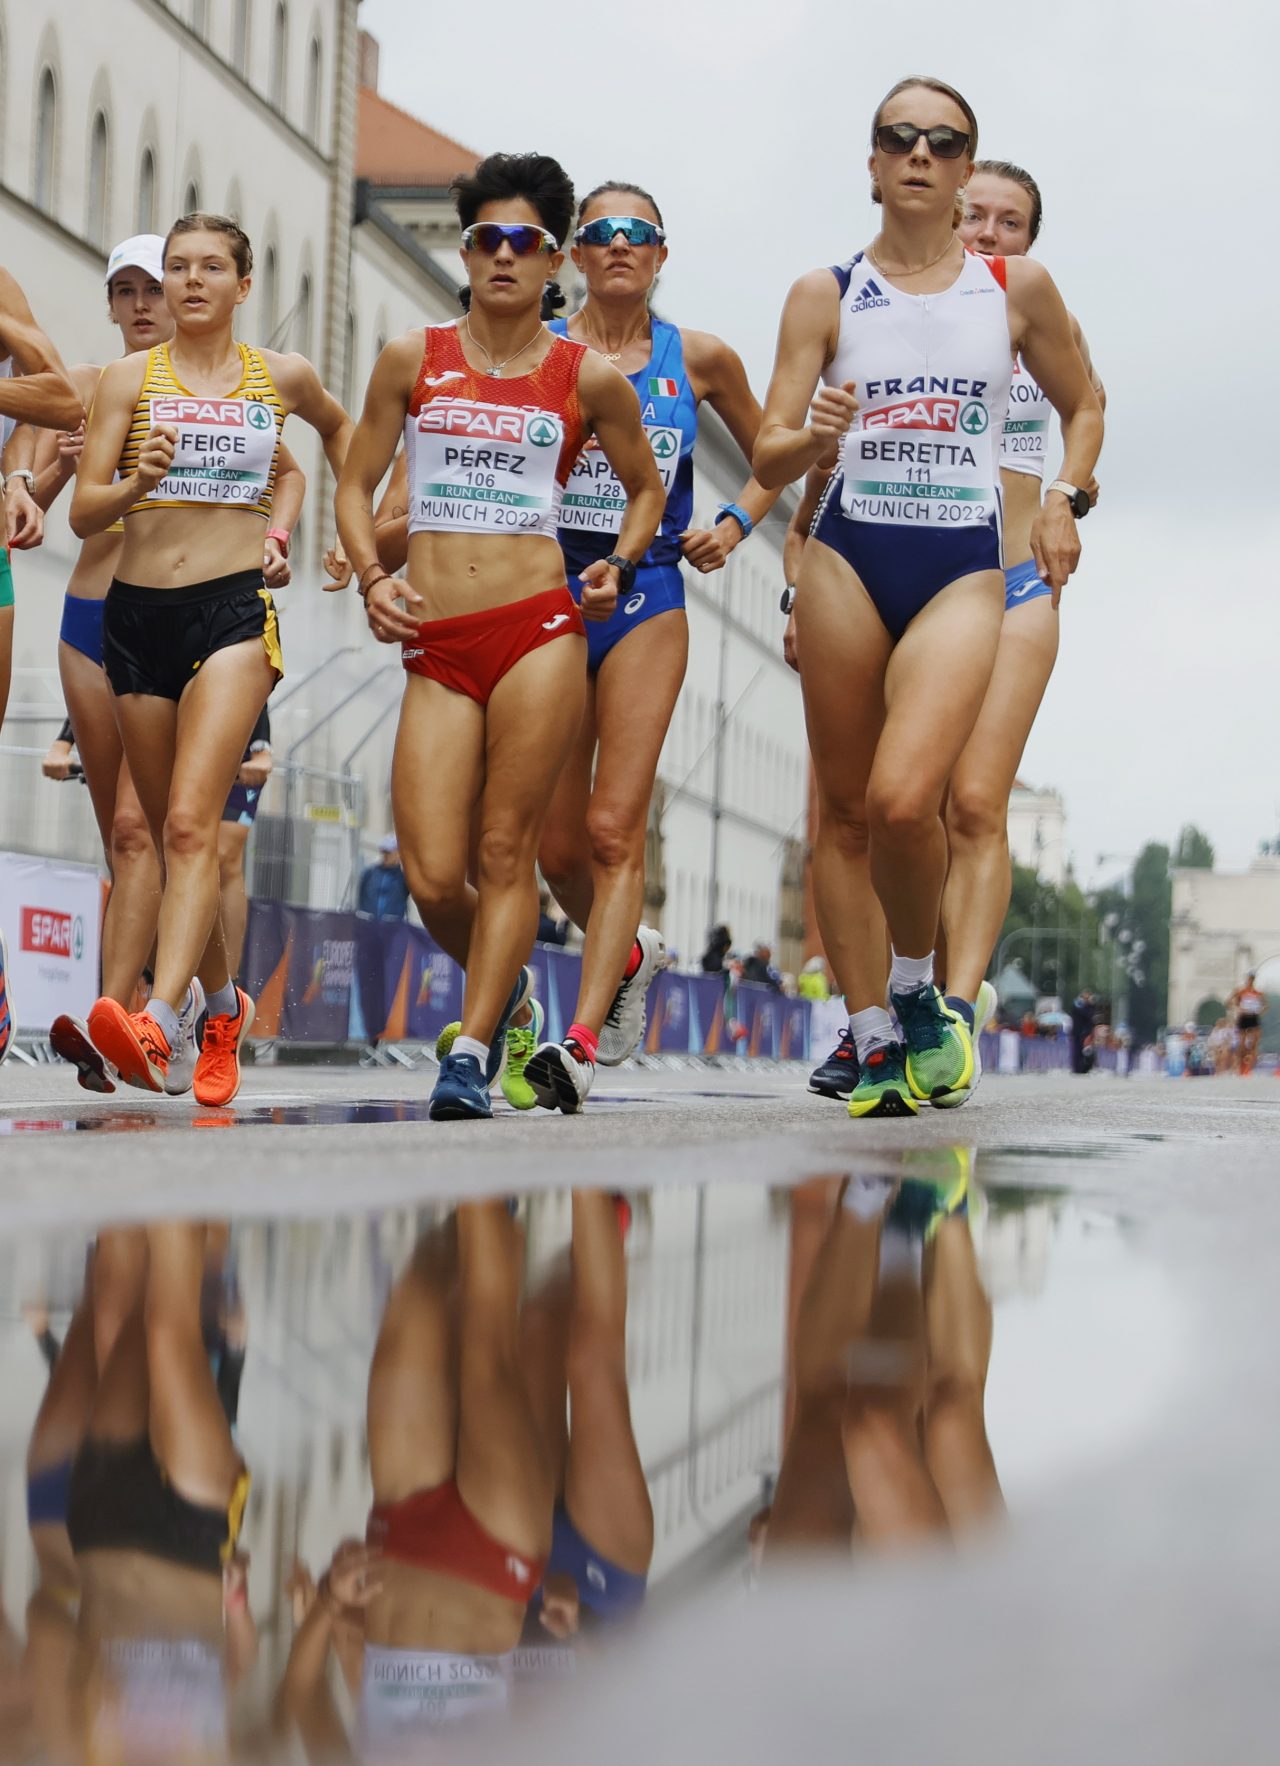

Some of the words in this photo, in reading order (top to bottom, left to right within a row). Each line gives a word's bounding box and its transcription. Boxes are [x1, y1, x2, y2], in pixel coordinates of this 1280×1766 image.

[850, 297, 891, 313] adidas
[865, 376, 987, 399] FRANCE
[156, 402, 241, 423] SPAR
[866, 402, 956, 429] SPAR
[421, 409, 520, 438] SPAR
[181, 433, 246, 454] FEIGE
[860, 440, 977, 467] BERETTA
[1012, 436, 1042, 452] 2022
[201, 456, 226, 468] 116
[445, 445, 526, 475] PÉREZ
[183, 469, 206, 477] RUN
[466, 471, 495, 487] 106
[906, 467, 931, 483] 111
[156, 480, 219, 498] MUNICH
[222, 484, 259, 500] 2022
[445, 486, 472, 498] RUN
[594, 483, 621, 497] 128
[885, 484, 913, 496] RUN
[577, 496, 601, 507] RUN
[604, 499, 628, 509] CLEA
[850, 498, 930, 520] MUNICH
[938, 504, 985, 521] 2022
[421, 500, 487, 521] MUNICH
[494, 508, 540, 527] 2022
[31, 913, 70, 949] SPAR
